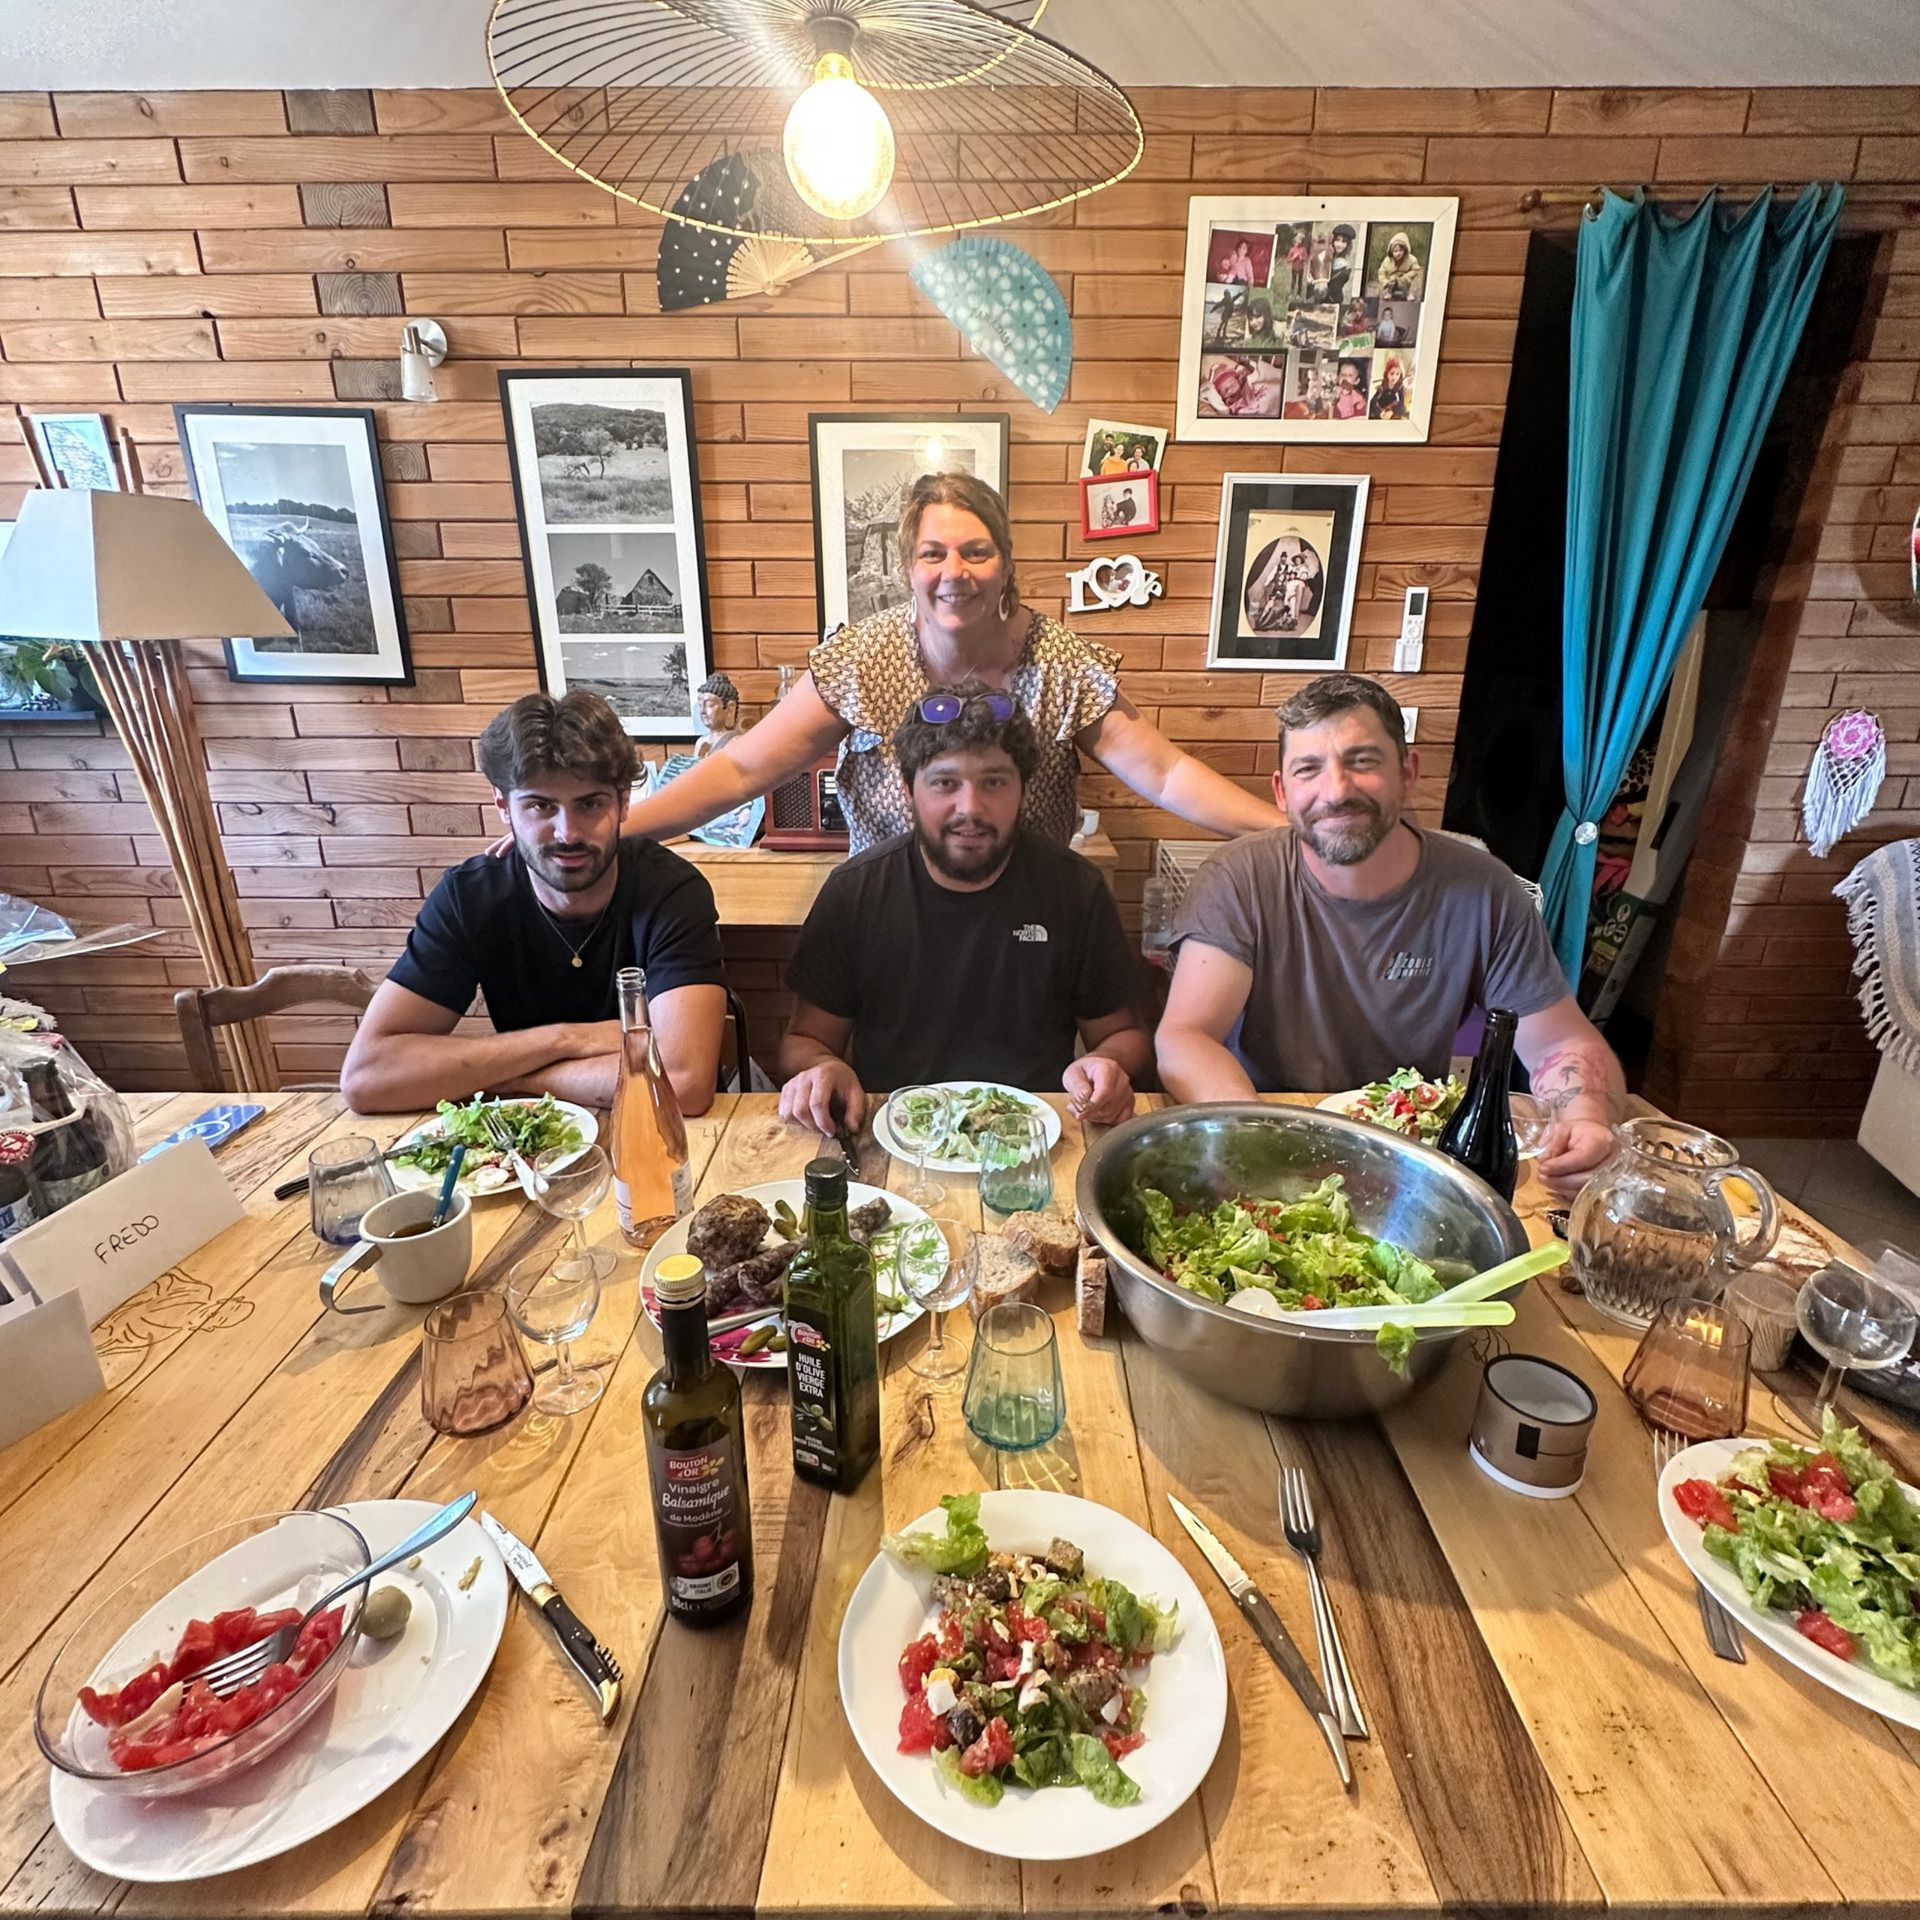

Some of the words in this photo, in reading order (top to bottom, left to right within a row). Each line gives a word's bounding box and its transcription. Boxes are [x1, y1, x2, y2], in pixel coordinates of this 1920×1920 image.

[95, 1215, 159, 1265] FREDO
[798, 1352, 822, 1369] HUILE
[795, 1361, 826, 1380] D'OLIVE
[797, 1371, 825, 1389] VIERGE
[799, 1382, 824, 1398] EXTRA
[669, 1456, 708, 1469] BOUTON
[668, 1479, 720, 1494] Vinaigre
[662, 1486, 730, 1509] Balsamique
[669, 1514, 682, 1522] de
[683, 1507, 723, 1522] Modène
